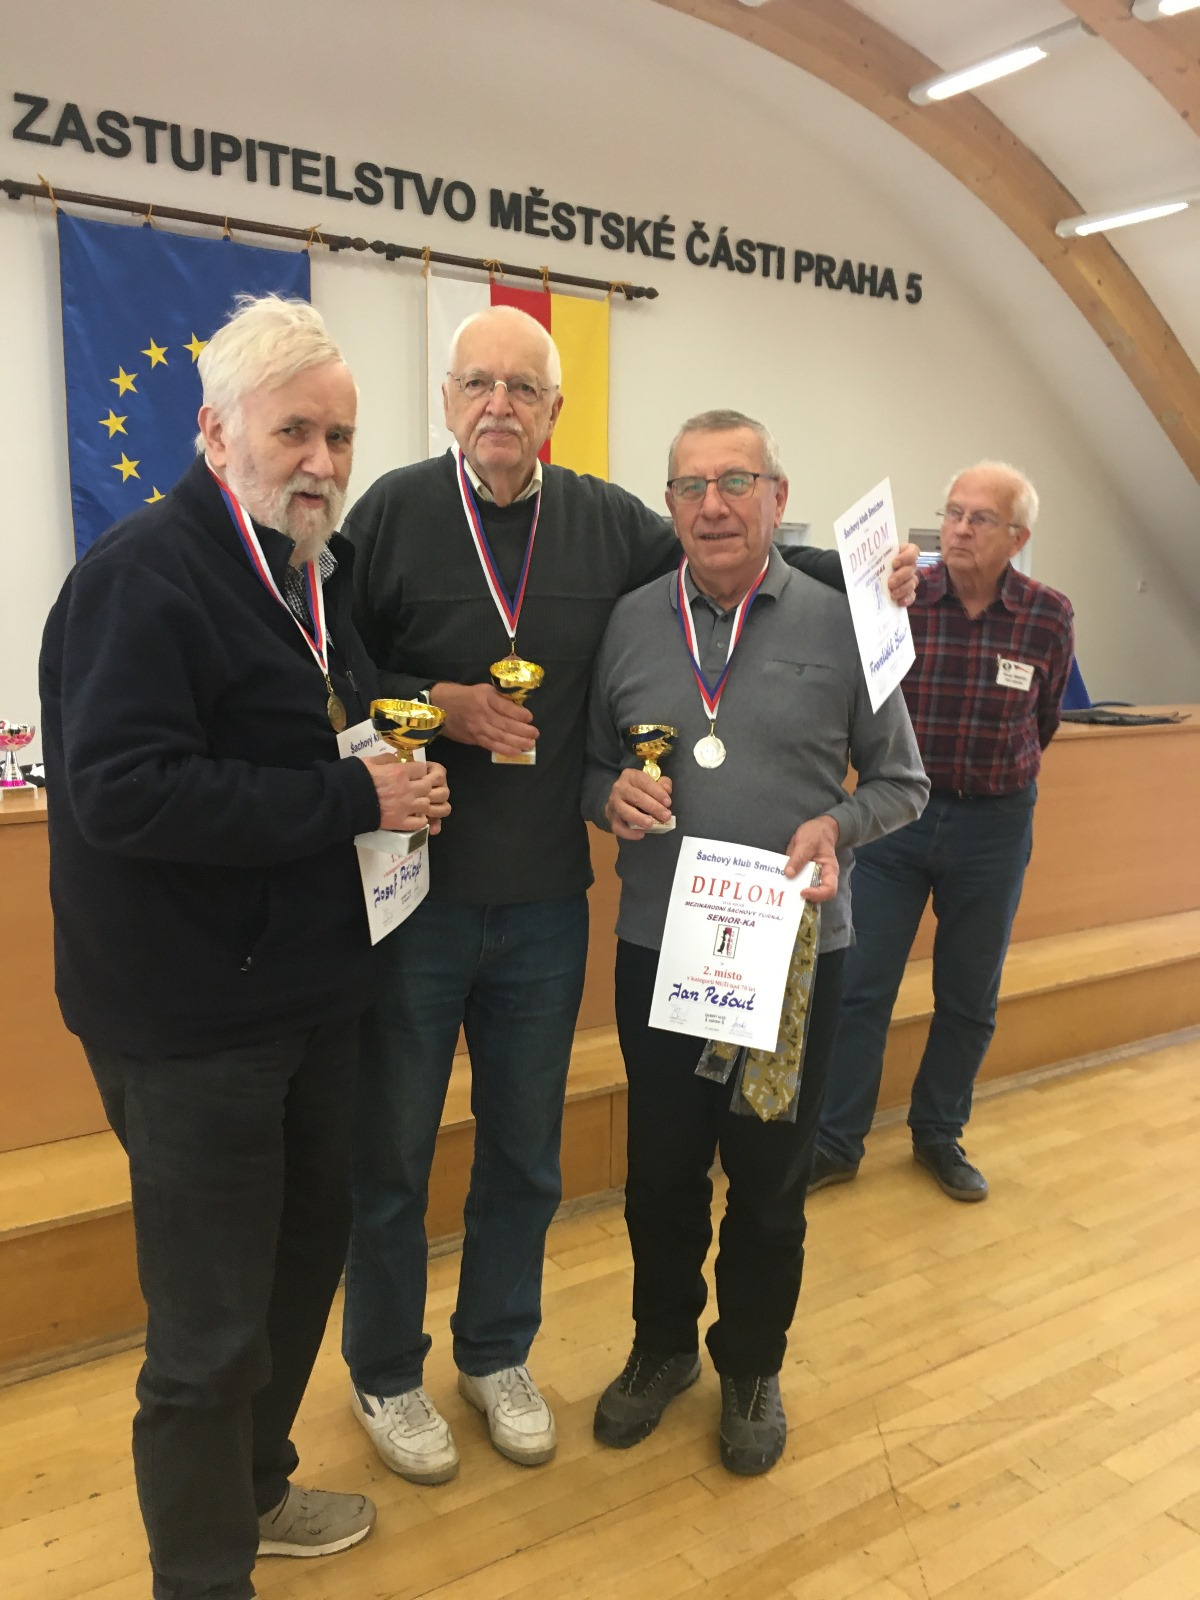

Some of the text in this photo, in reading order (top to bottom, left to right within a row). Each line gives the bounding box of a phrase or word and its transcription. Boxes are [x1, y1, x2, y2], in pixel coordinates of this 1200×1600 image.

[12, 91, 924, 305] ZASTUPITELSTVO MĚSTSKÉ ČÁSTI PRAHA 5
[848, 521, 890, 574] DIPLOM
[696, 849, 731, 867] Šachový
[733, 857, 752, 868] klub
[373, 872, 398, 909] Josef
[691, 875, 786, 907] DIPLOM
[706, 913, 756, 927] SENIOR-KA
[702, 965, 712, 976] 2.
[668, 982, 756, 1011] Jan Pešout
